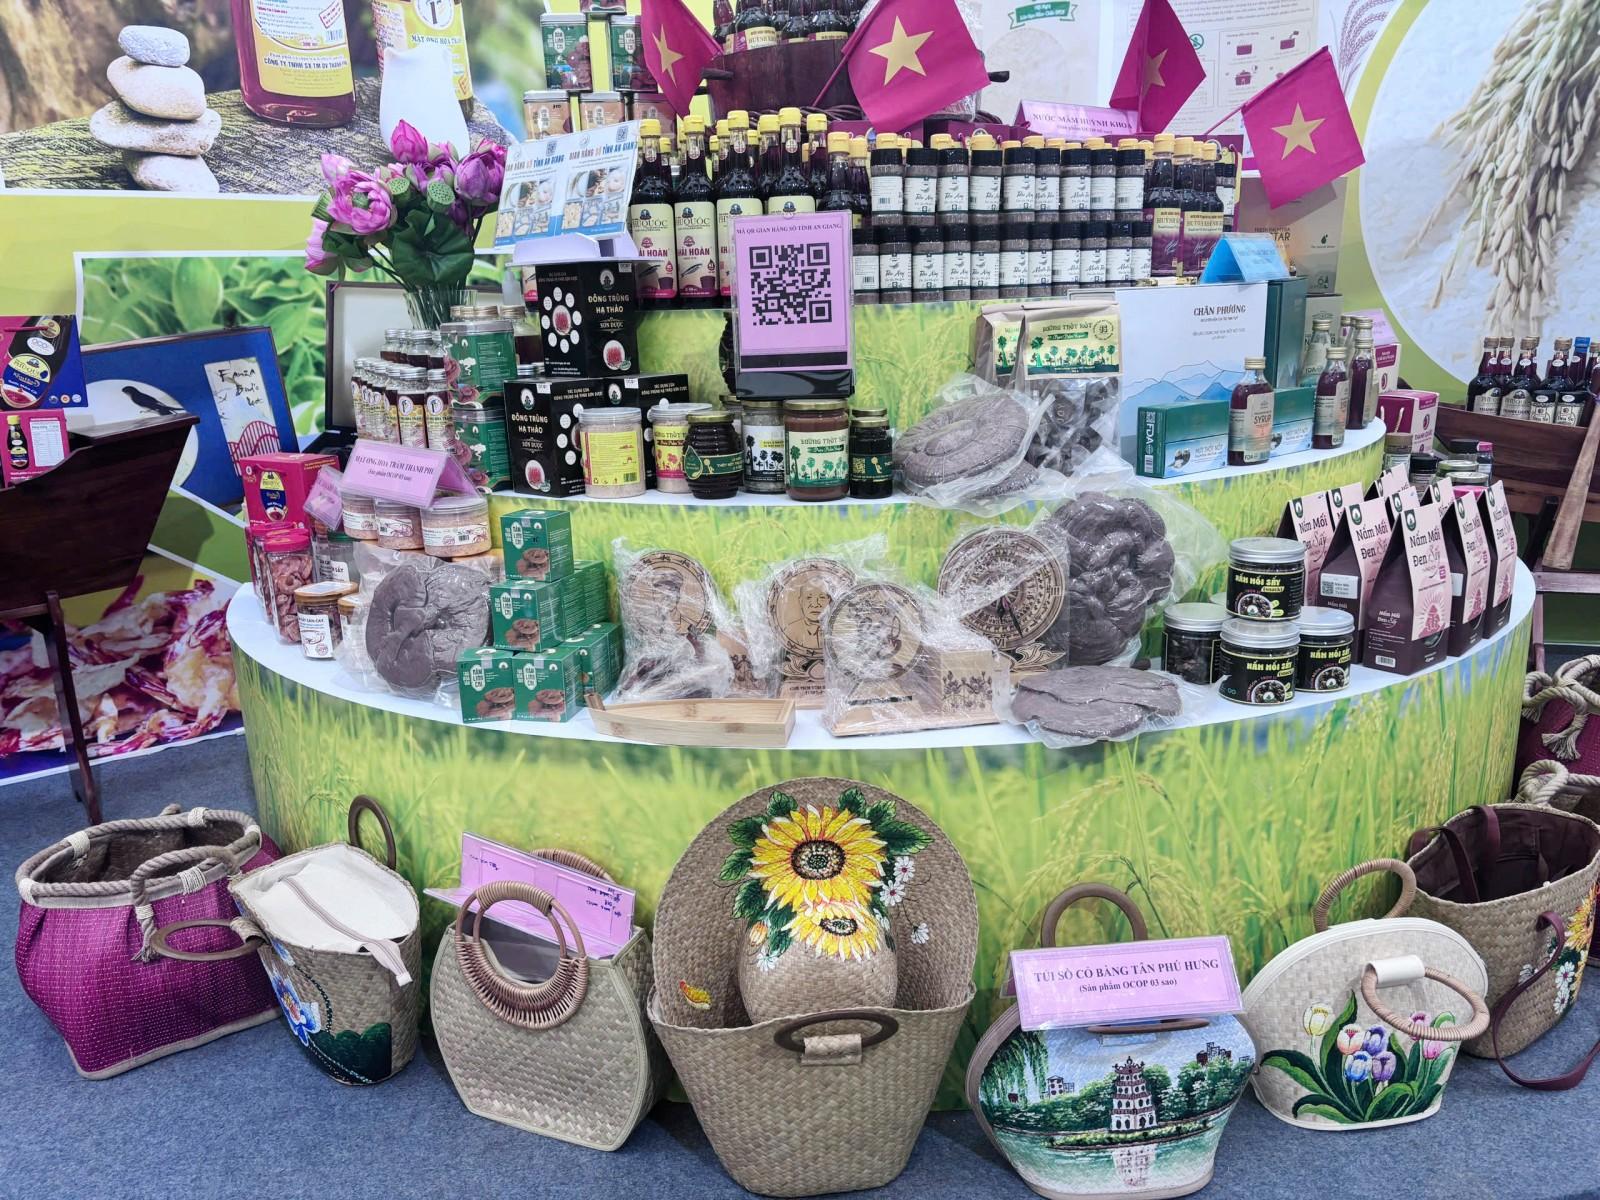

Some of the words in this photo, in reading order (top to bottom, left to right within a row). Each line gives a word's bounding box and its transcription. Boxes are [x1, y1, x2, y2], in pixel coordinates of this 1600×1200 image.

[588, 294, 607, 303] ĐÔNG
[608, 292, 629, 302] TRÙNG
[596, 306, 606, 314] HẠ
[607, 305, 623, 313] THẢO
[512, 414, 528, 423] ĐÔNG
[529, 414, 548, 423] TRÙNG
[518, 426, 526, 434] HẠ
[528, 425, 543, 433] THẢO
[1146, 423, 1155, 444] FDA
[1312, 514, 1328, 530] Mối
[1356, 524, 1375, 542] Nấm
[1375, 520, 1388, 536] Mối
[1410, 530, 1427, 548] Nấm
[1428, 525, 1441, 543] Mối
[1361, 548, 1376, 559] Đen
[1413, 554, 1427, 567] Đen
[1250, 575, 1264, 585] MỐI
[1266, 575, 1281, 586] SẤY
[1328, 648, 1340, 658] MỐI
[1247, 660, 1263, 671] NẤM
[1265, 660, 1279, 670] MỐI
[1281, 659, 1293, 669] SẤY
[1034, 971, 1056, 982] TÚI
[1076, 966, 1092, 979] CỎ
[1131, 963, 1155, 975] TÂN
[1158, 959, 1182, 973] PHÚ
[1184, 958, 1219, 971] HƯNG
[1079, 984, 1097, 993] (Sản
[1099, 981, 1121, 992] phẩm
[1123, 980, 1148, 989] OCOP
[1161, 977, 1178, 986] sao)
